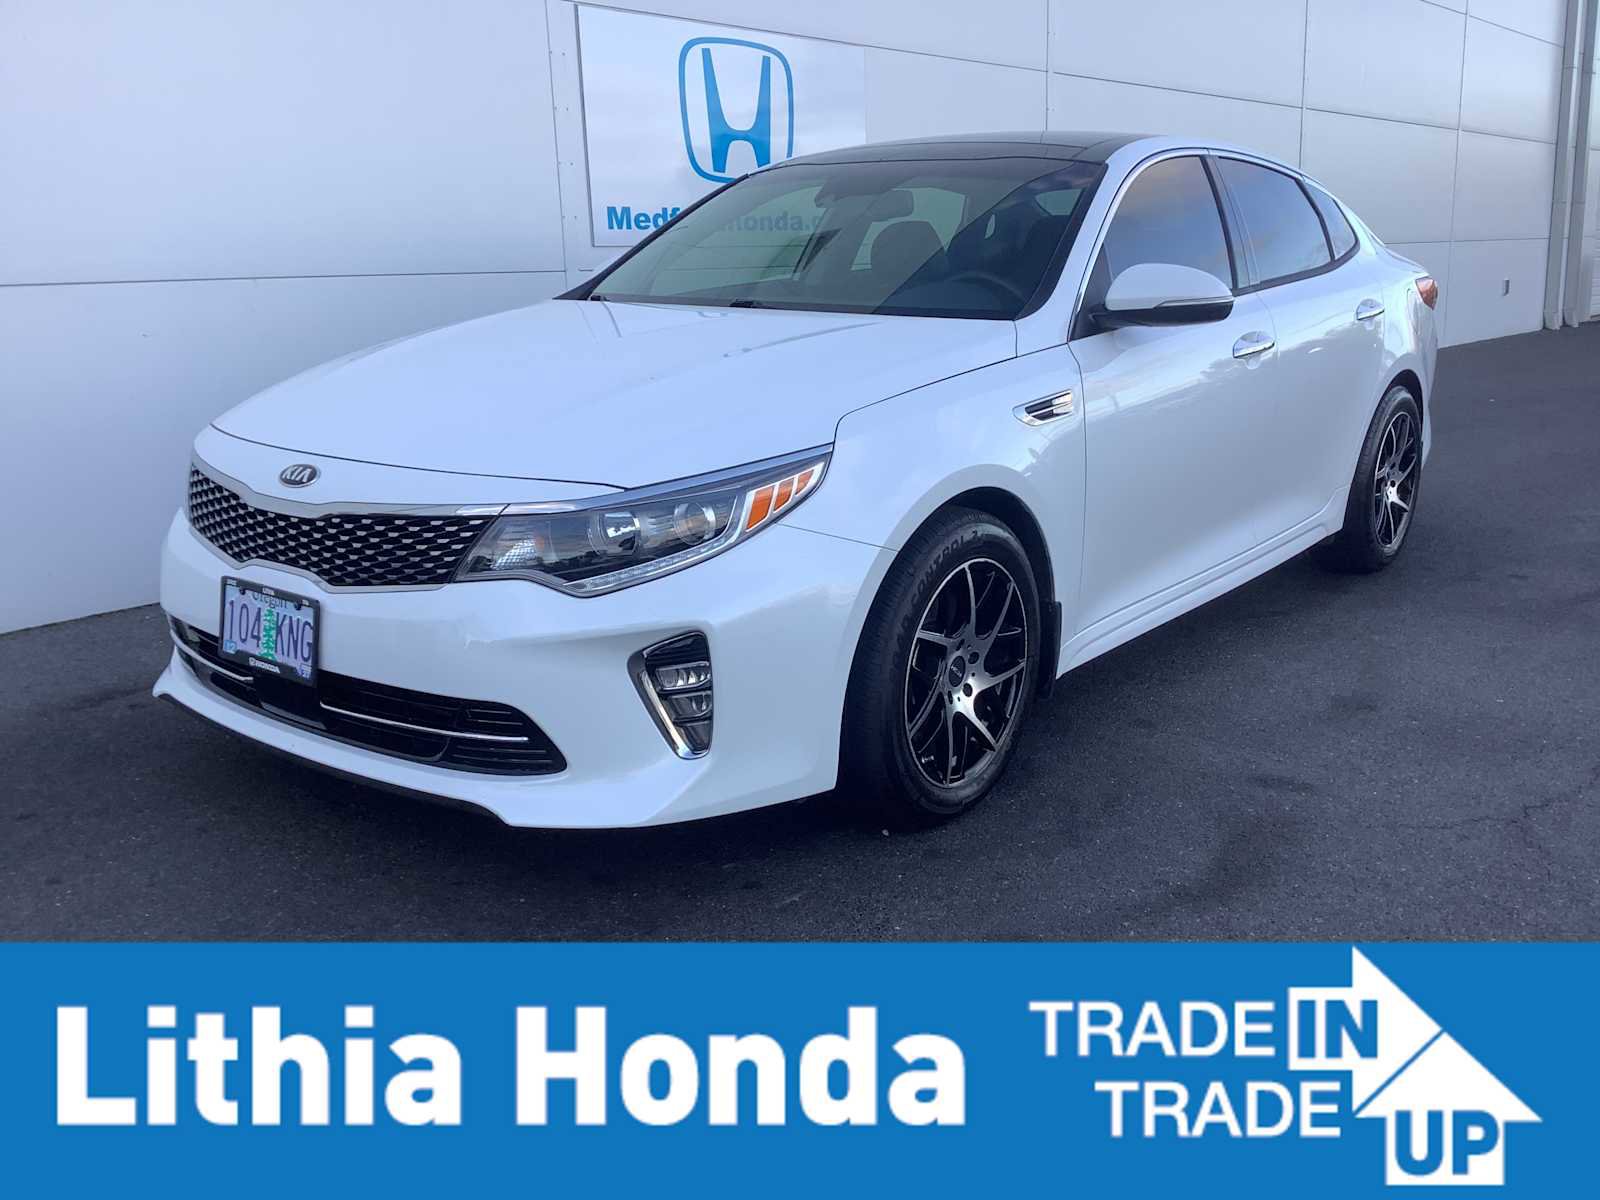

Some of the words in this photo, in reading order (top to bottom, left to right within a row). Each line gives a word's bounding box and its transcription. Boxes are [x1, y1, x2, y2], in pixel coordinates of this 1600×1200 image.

[282, 466, 312, 482] KIA
[229, 600, 261, 648] 104
[275, 612, 313, 662] KNG
